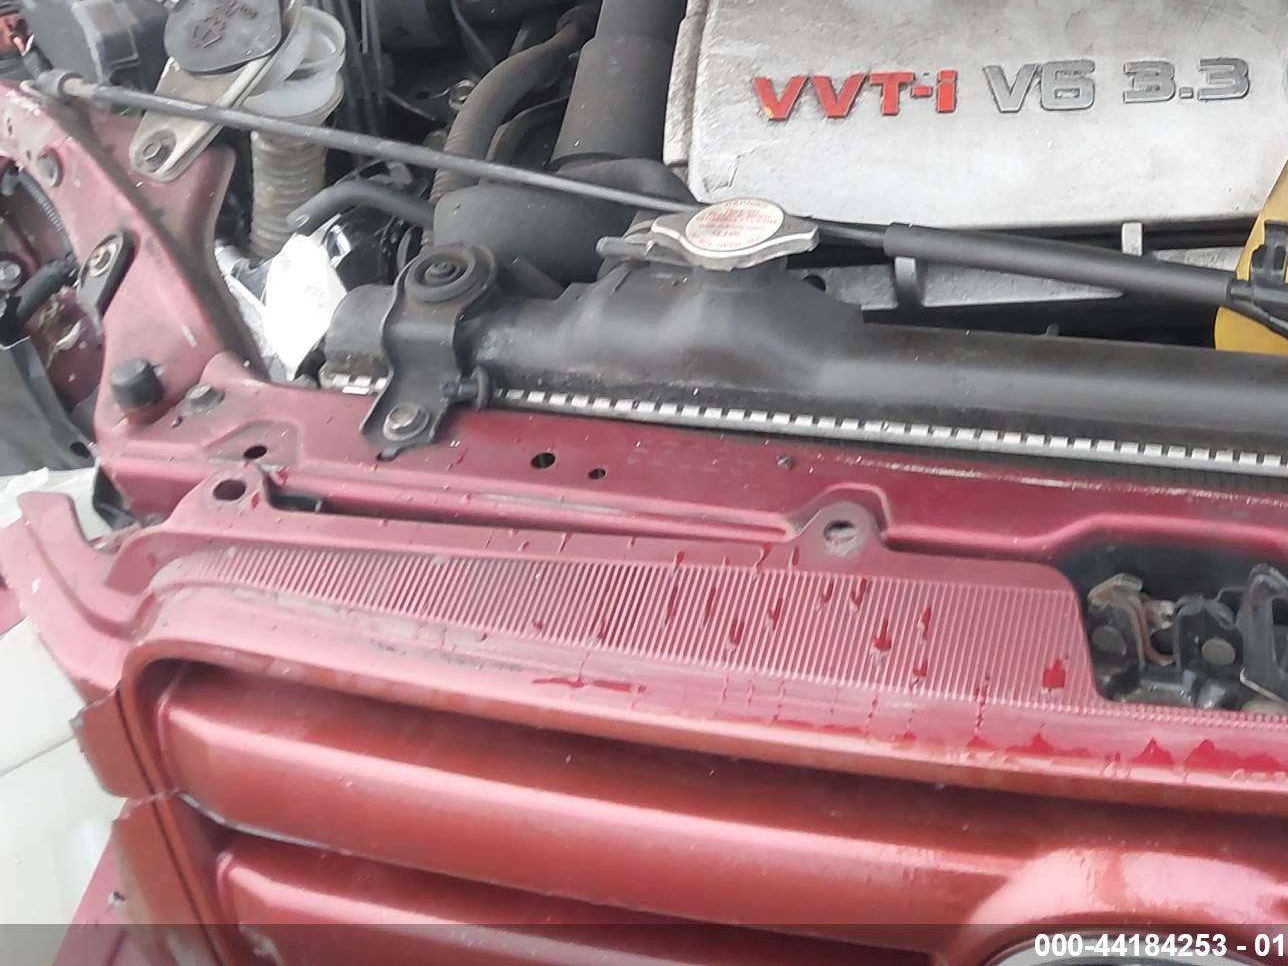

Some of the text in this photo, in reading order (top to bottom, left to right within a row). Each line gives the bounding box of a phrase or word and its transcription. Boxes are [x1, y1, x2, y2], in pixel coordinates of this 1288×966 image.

[753, 56, 1252, 121] VVT-i V6 3.3
